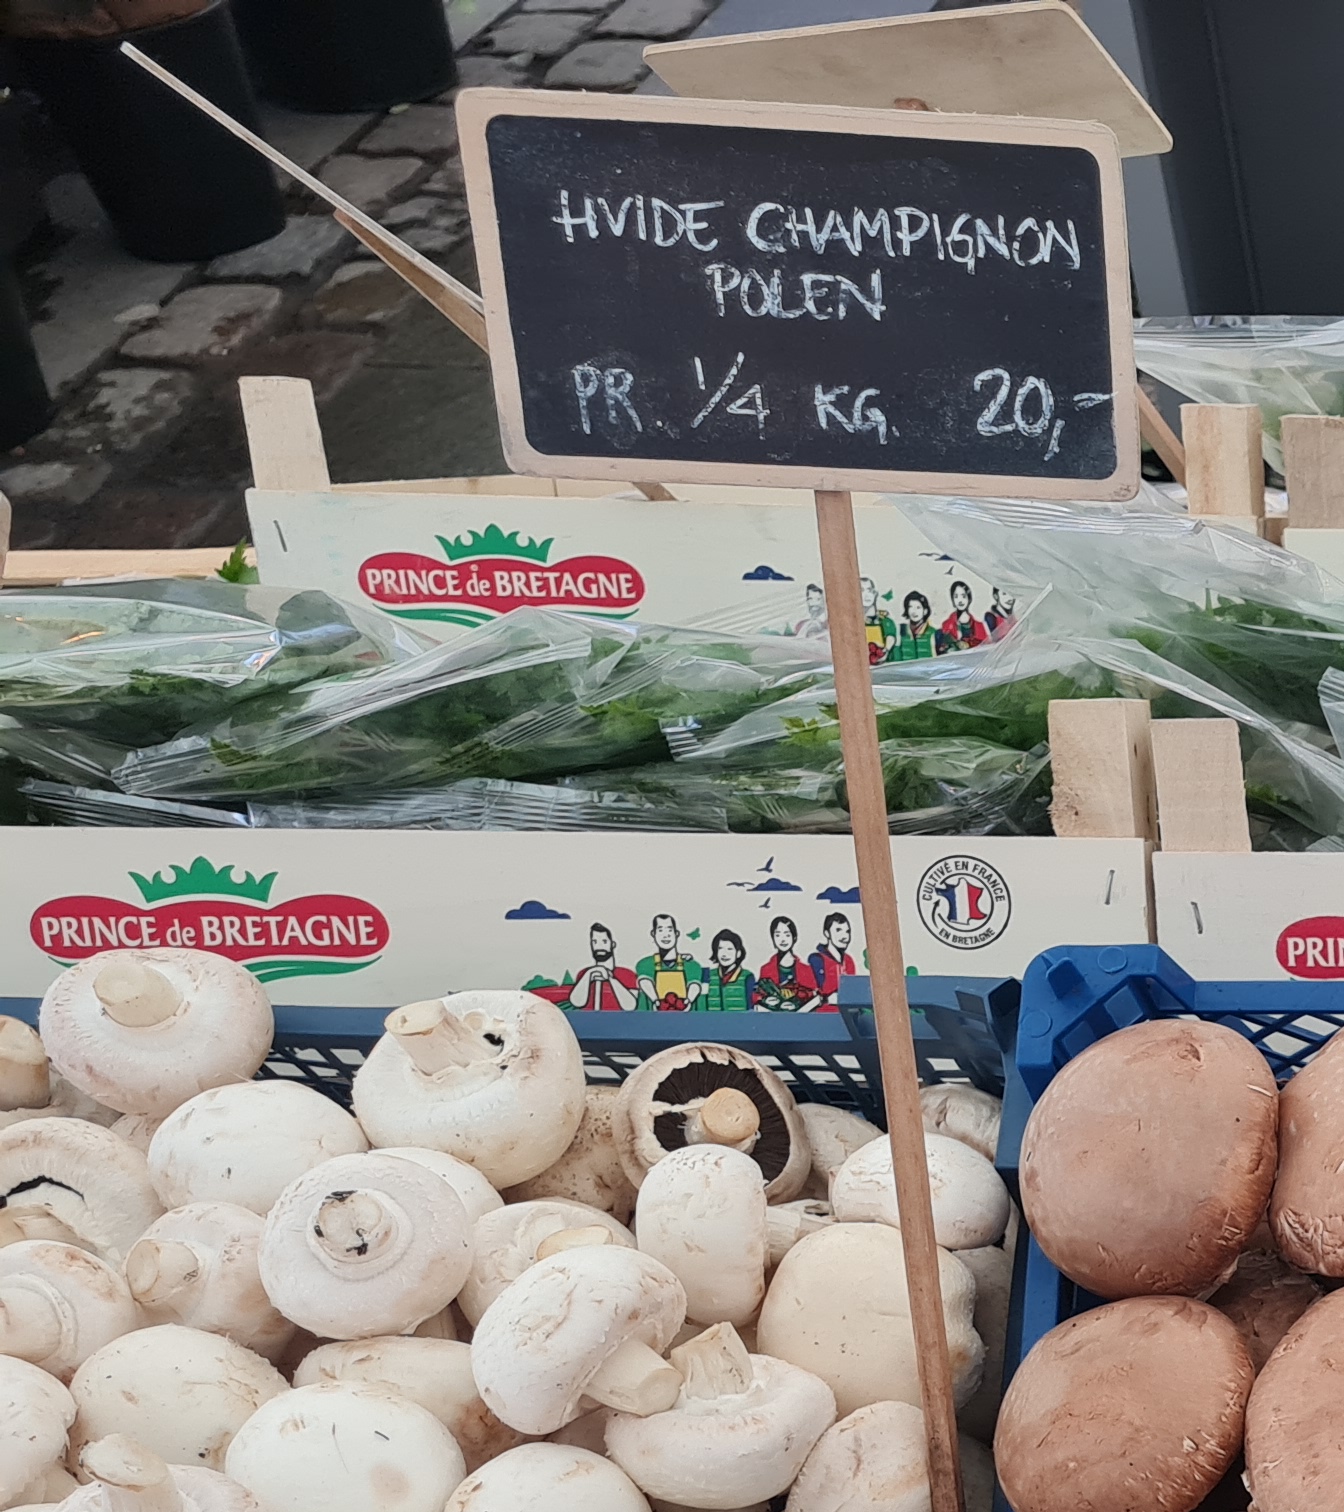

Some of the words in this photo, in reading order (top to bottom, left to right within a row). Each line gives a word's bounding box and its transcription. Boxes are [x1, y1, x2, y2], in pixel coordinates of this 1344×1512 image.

[552, 190, 724, 253] HVIDE
[745, 201, 1082, 275] CHAMPIGNON
[704, 263, 887, 322] POLEN
[691, 350, 772, 440] 1/4
[364, 568, 463, 597] PRINCE
[465, 564, 492, 597] de
[493, 570, 637, 599] BRETAGNE
[922, 861, 952, 901] CULTIVÉ
[954, 861, 969, 871] EN
[972, 863, 1006, 902] FRANCE
[39, 916, 161, 948] PRINCE
[166, 915, 197, 947] de
[200, 915, 378, 947] BRETAGNE
[938, 928, 951, 940] EN
[951, 927, 996, 945] BRETAGNE
